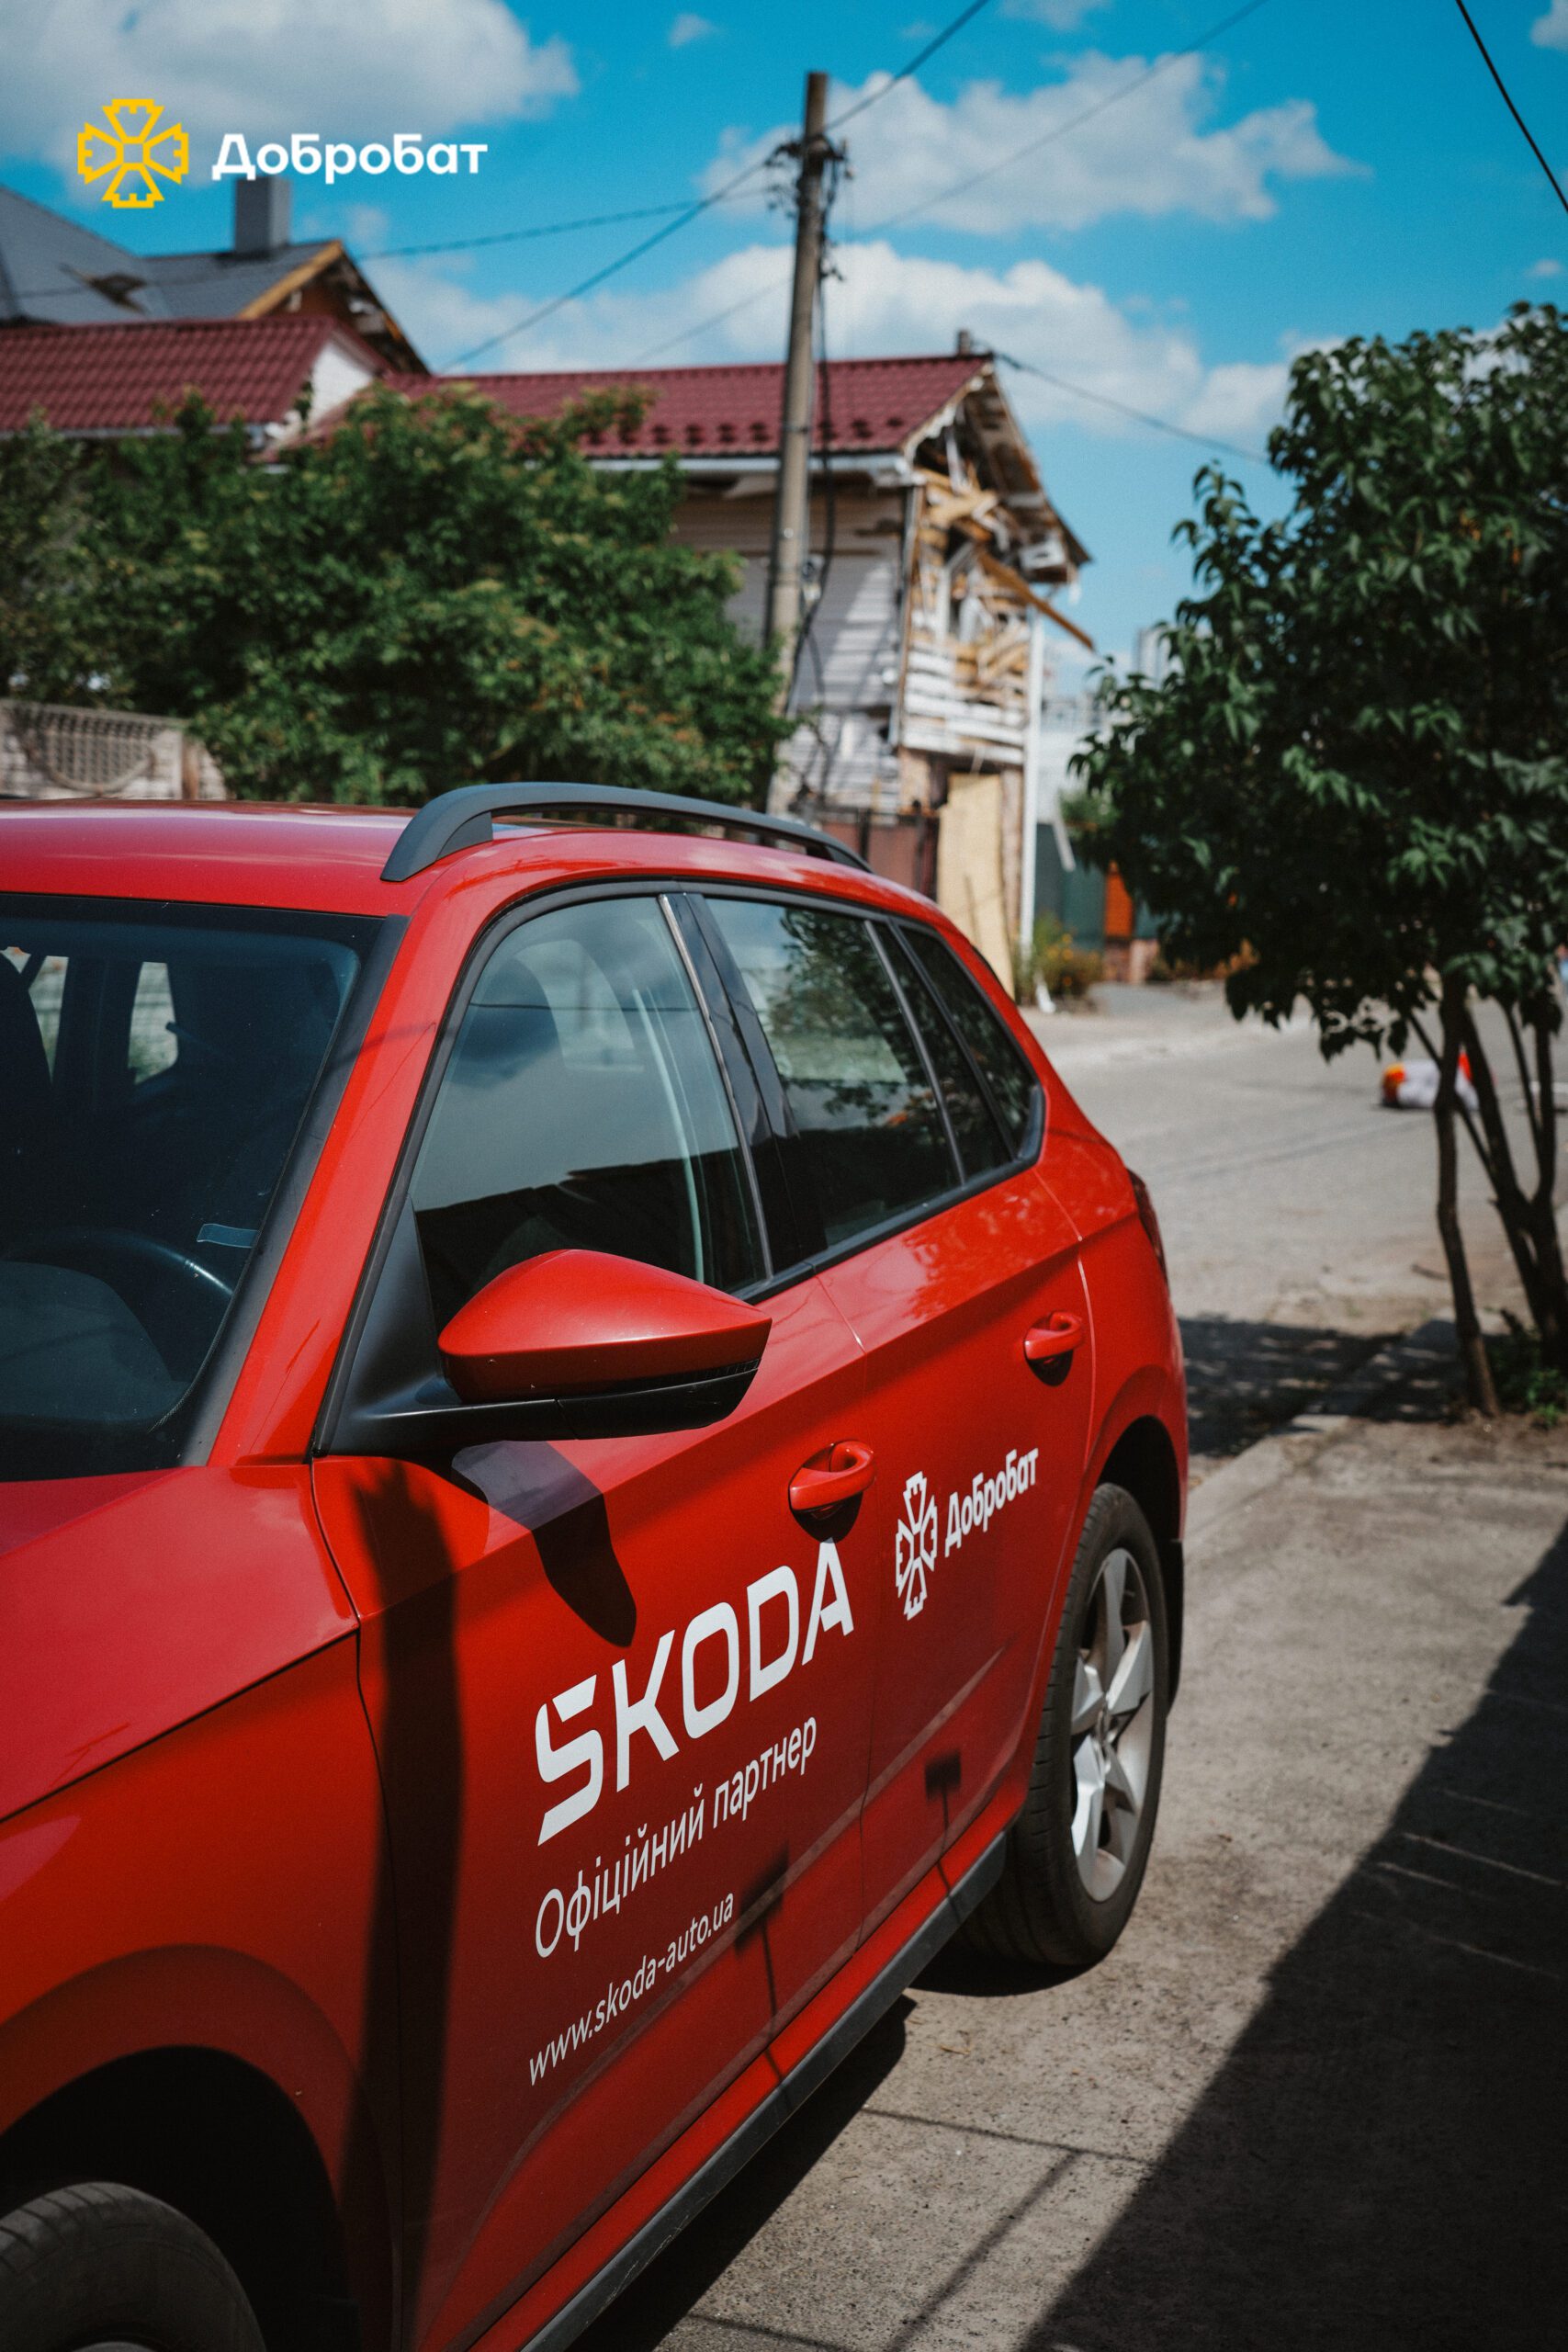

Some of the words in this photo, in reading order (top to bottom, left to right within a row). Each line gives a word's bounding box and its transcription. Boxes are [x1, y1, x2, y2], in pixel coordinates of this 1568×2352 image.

[944, 1448, 1039, 1557] Добробат
[536, 1782, 705, 1959] Офіційний
[713, 1716, 817, 1822] партнер
[529, 1892, 734, 2086] www.skoda-auto.ua
